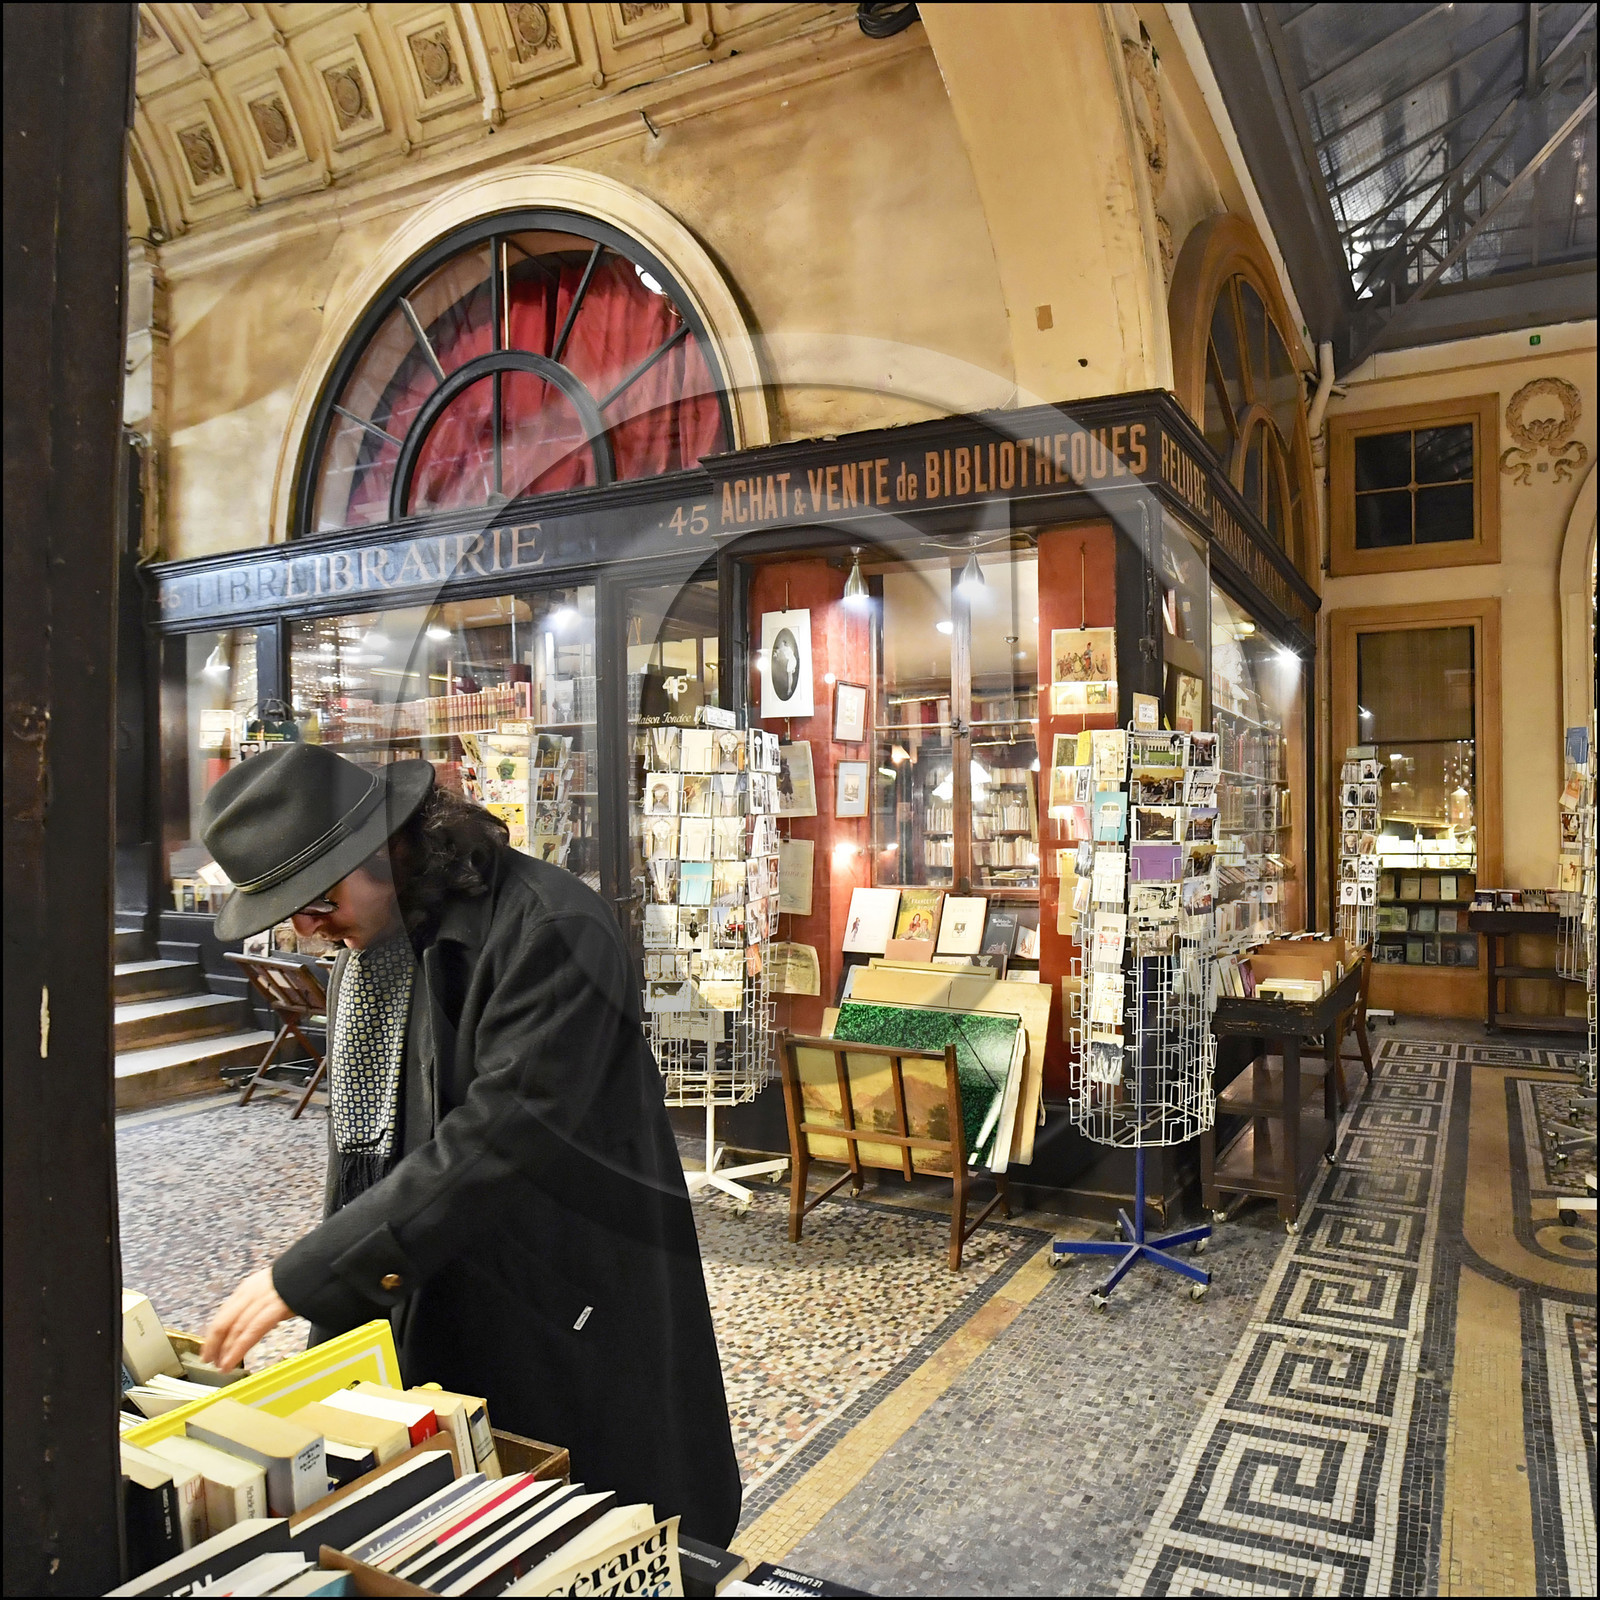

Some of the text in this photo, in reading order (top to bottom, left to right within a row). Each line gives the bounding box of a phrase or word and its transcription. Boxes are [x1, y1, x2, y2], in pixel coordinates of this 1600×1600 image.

[721, 423, 1147, 525] ACHAT & VENTE de BIBLIOTHEQUES
[1161, 430, 1209, 517] RELIURE
[668, 505, 709, 535] 45
[285, 523, 546, 599] LIBRAIRIE
[662, 675, 688, 694] 45
